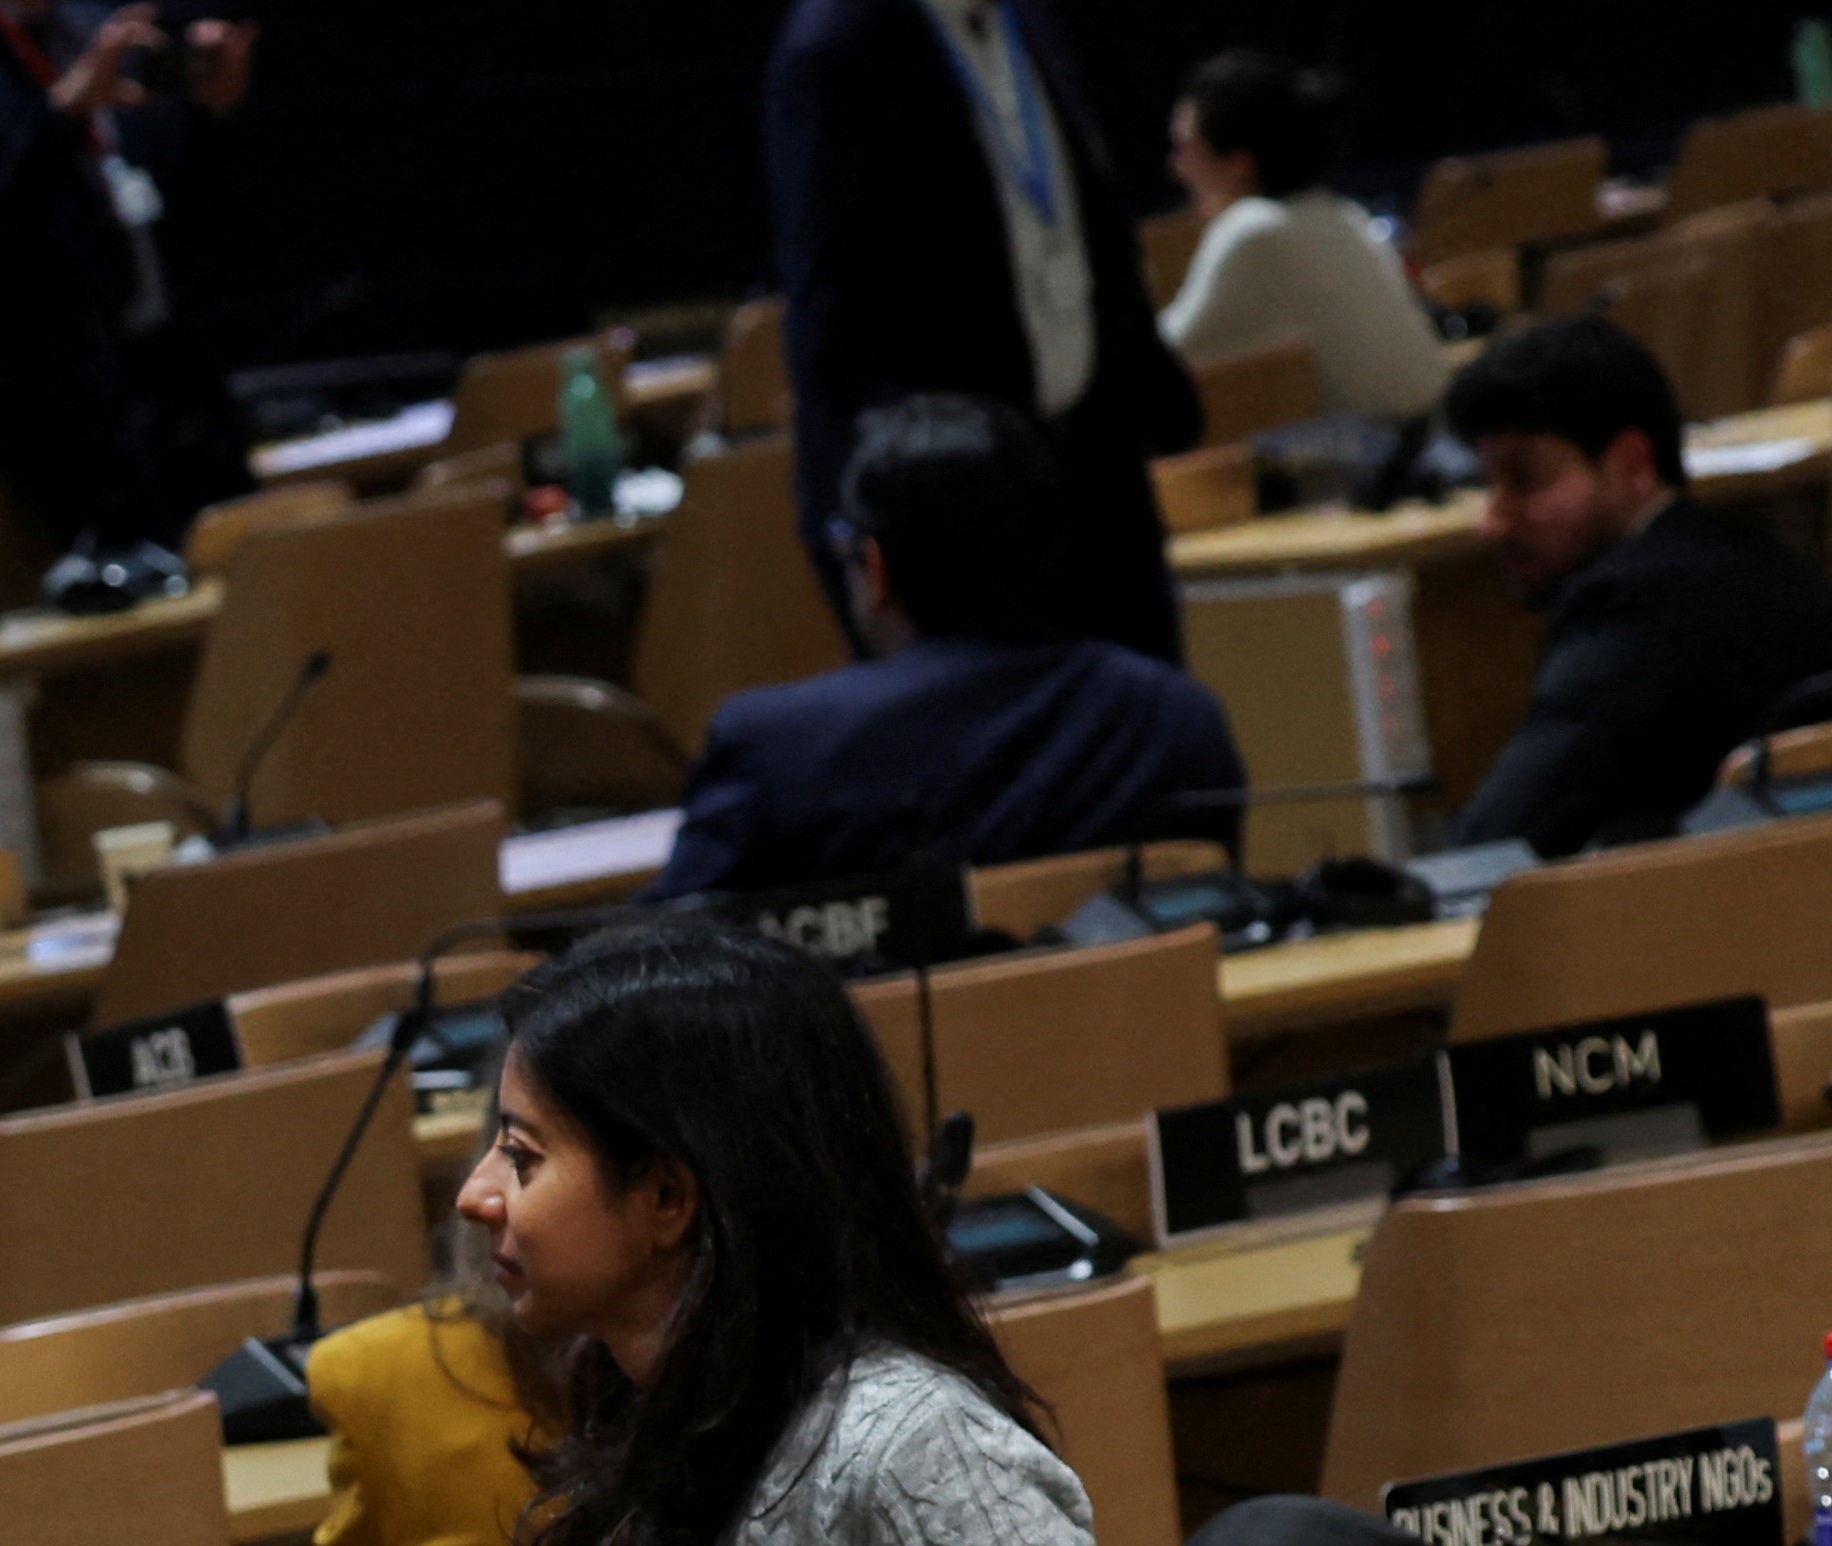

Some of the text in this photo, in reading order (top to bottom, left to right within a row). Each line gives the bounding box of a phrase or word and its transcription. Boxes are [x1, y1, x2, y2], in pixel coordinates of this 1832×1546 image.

[1535, 1030, 1662, 1099] NCM
[1237, 1091, 1369, 1174] LCBC
[1537, 1480, 1560, 1535] &
[1562, 1454, 1696, 1540] INDUSTRY
[1699, 1444, 1773, 1513] NGOs
